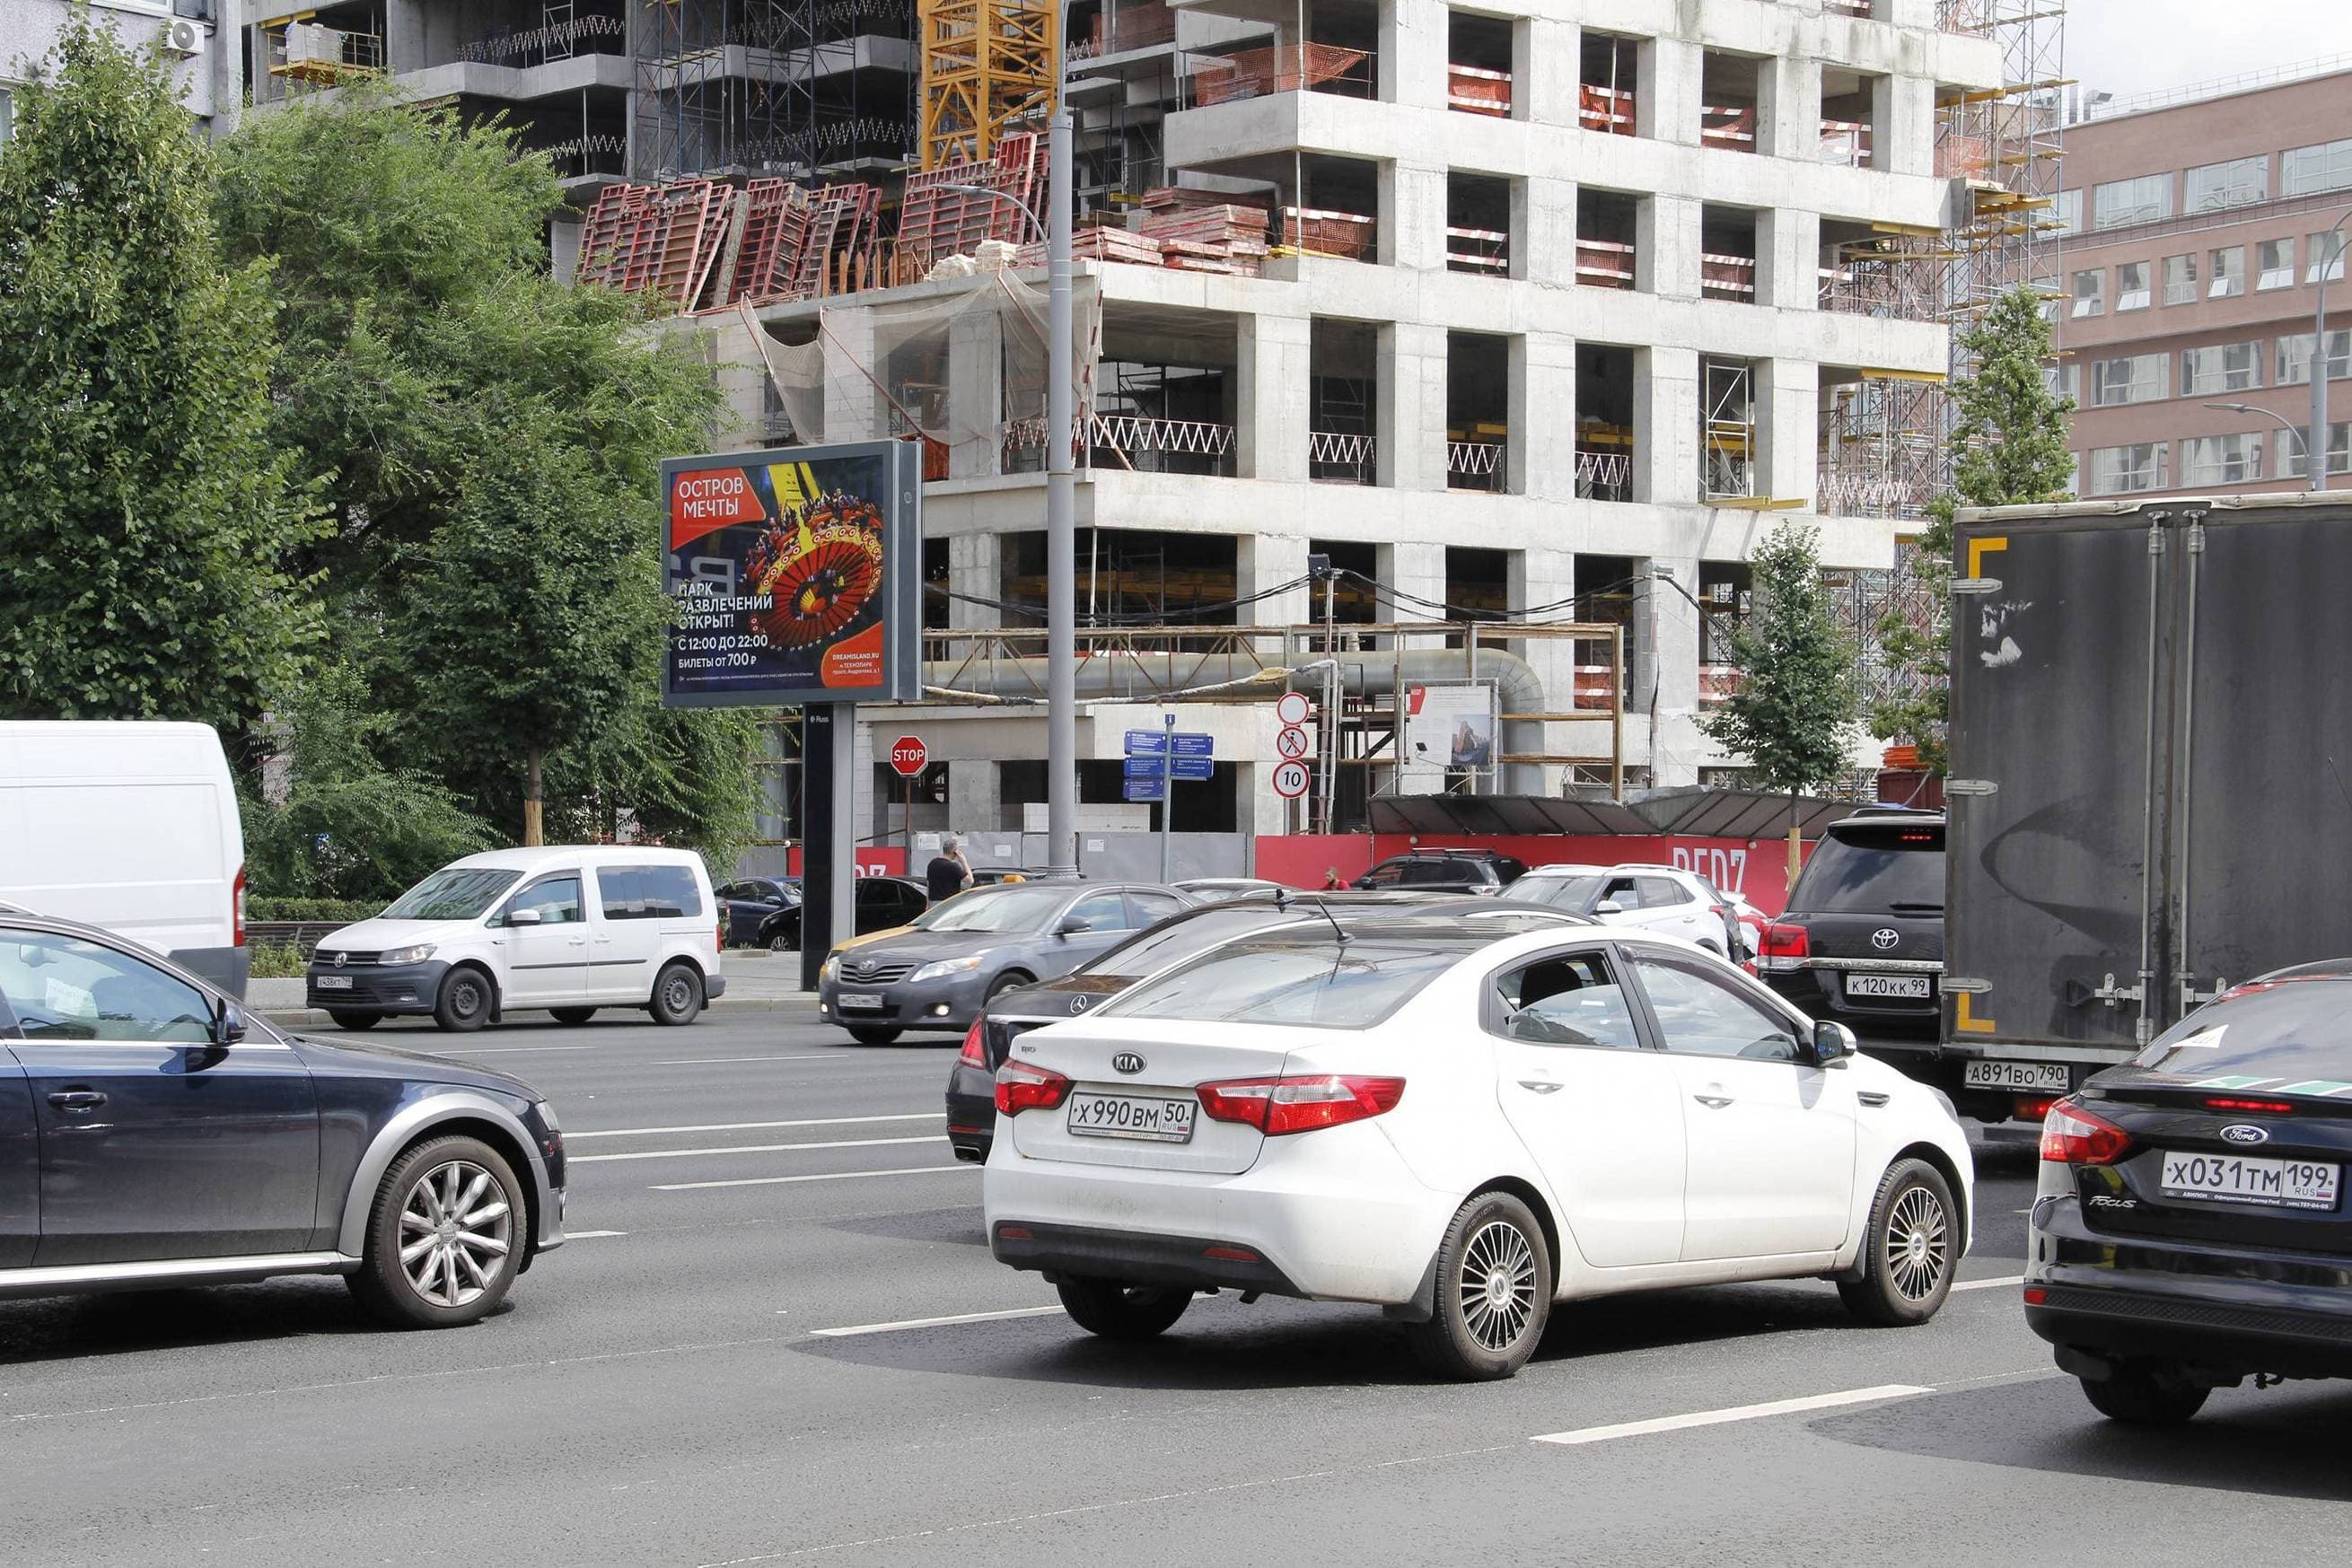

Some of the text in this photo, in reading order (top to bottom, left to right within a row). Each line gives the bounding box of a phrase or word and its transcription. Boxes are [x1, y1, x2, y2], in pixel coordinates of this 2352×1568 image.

[679, 477, 743, 498] ОСТРОВ
[683, 498, 739, 519] МЕЧТЫ
[678, 583, 714, 597] ПАРК
[678, 591, 773, 613] РАЗВЛЕЧЕНИЙ
[679, 614, 734, 629] ОТКРЫТ!
[678, 635, 768, 651] С 12:00 ДО 22:00
[678, 658, 714, 668] БИЛЕТЫ
[727, 653, 749, 666] 700
[832, 653, 880, 661] DREAMISLAND.RU
[893, 749, 925, 762] STOP
[1284, 770, 1302, 787] 10
[1911, 979, 1926, 992] 99
[1116, 1056, 1139, 1070] KIA
[2039, 1065, 2064, 1081] 790
[1164, 1103, 1185, 1123] 50
[1163, 1122, 1177, 1130] RUS
[2228, 1128, 2257, 1141] Ford
[2286, 1163, 2328, 1187] 199
[2295, 1187, 2316, 1196] RUS
